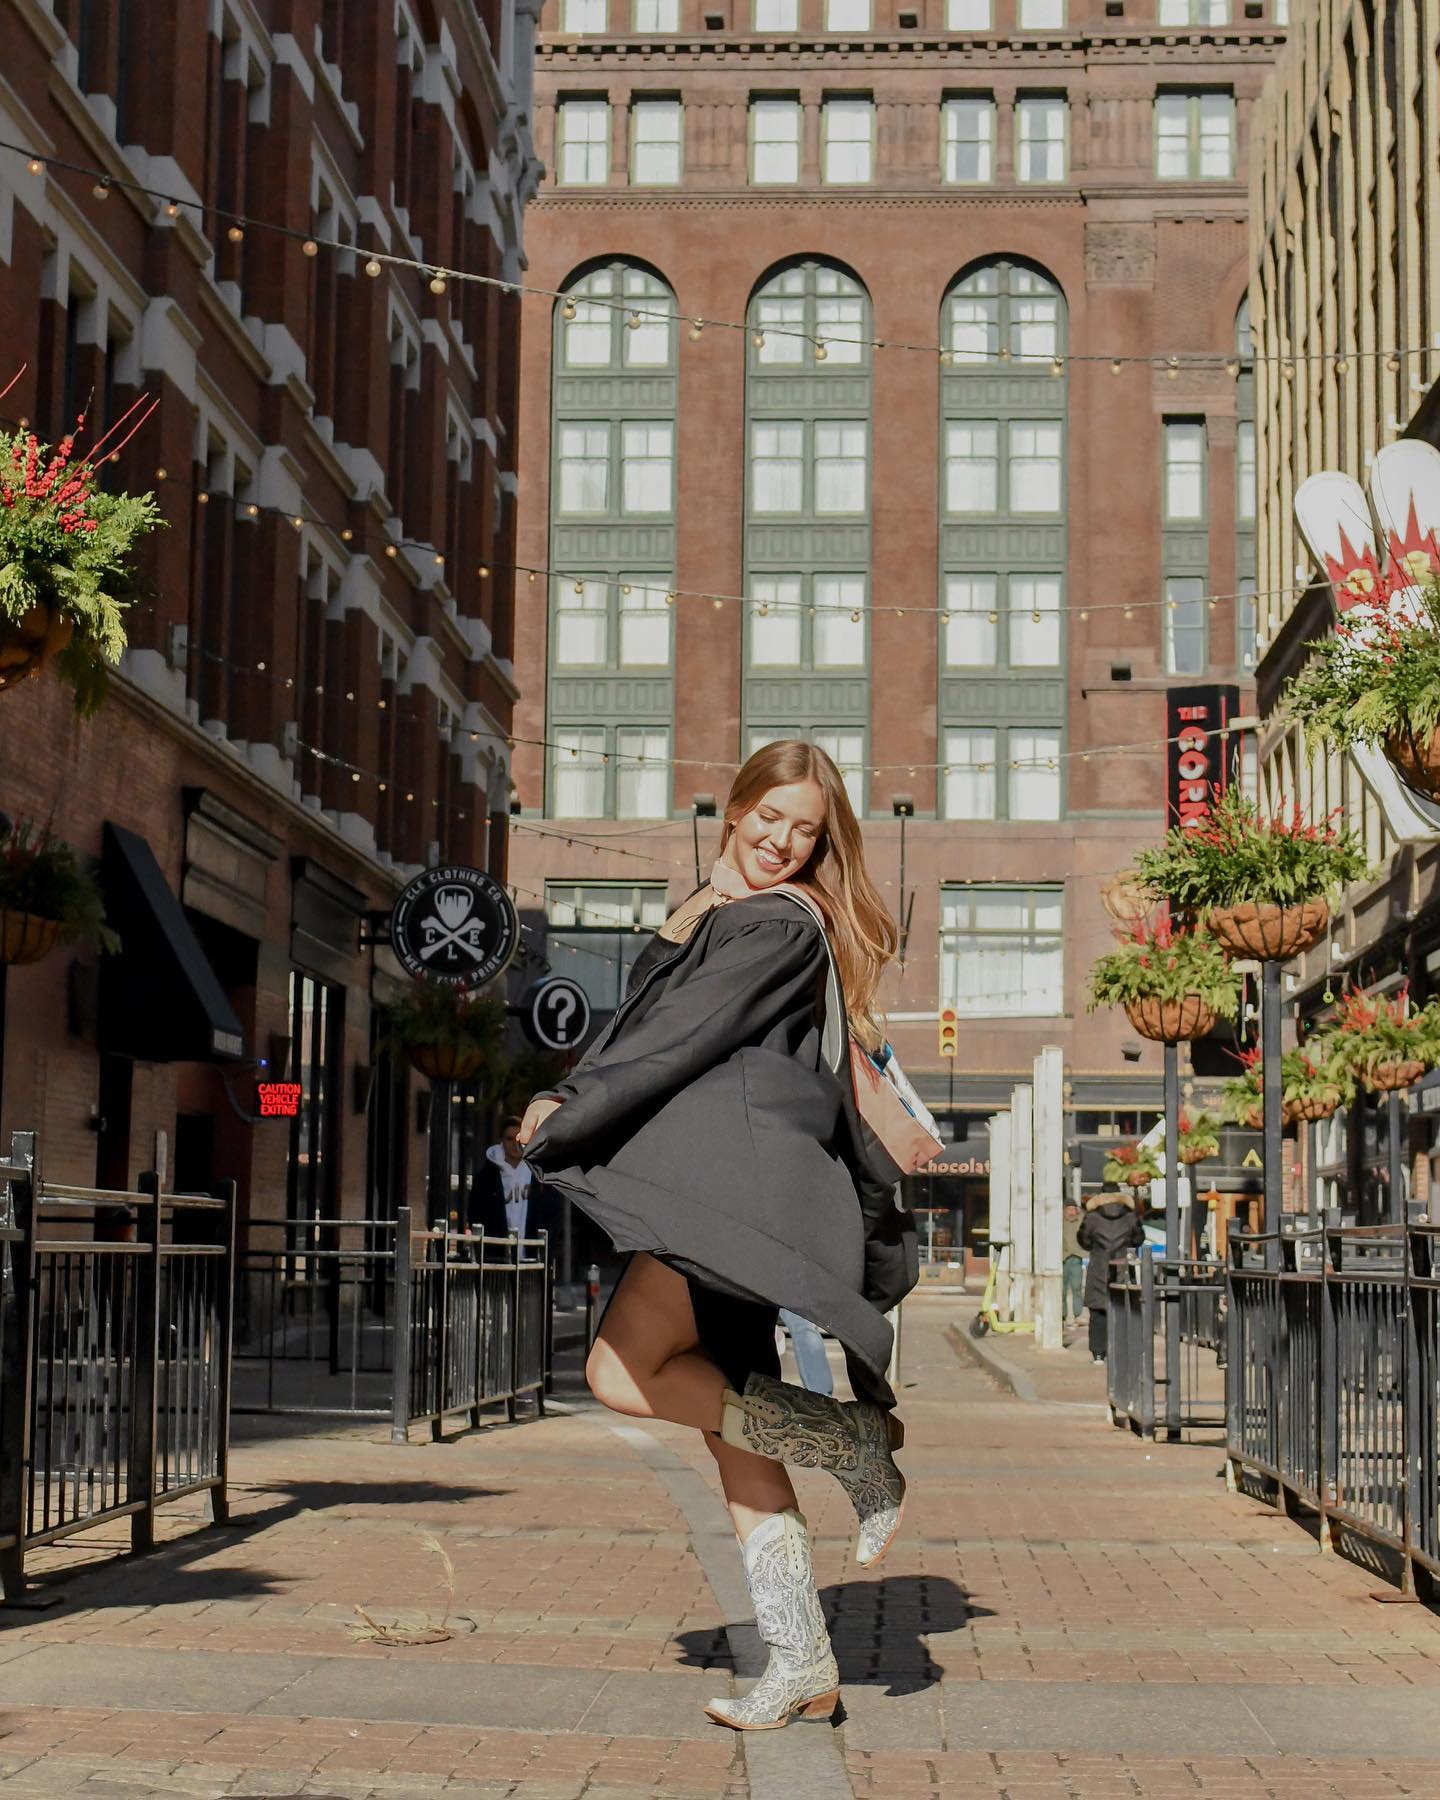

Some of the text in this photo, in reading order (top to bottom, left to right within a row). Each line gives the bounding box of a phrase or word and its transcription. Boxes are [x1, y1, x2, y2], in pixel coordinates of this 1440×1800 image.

[405, 880, 426, 900] CLE
[429, 869, 485, 887] CLOTHING
[471, 955, 501, 982] PRIDE
[258, 1083, 301, 1094] CAUTION
[260, 1094, 299, 1104] VEHICLE
[261, 1104, 297, 1115] EXITING
